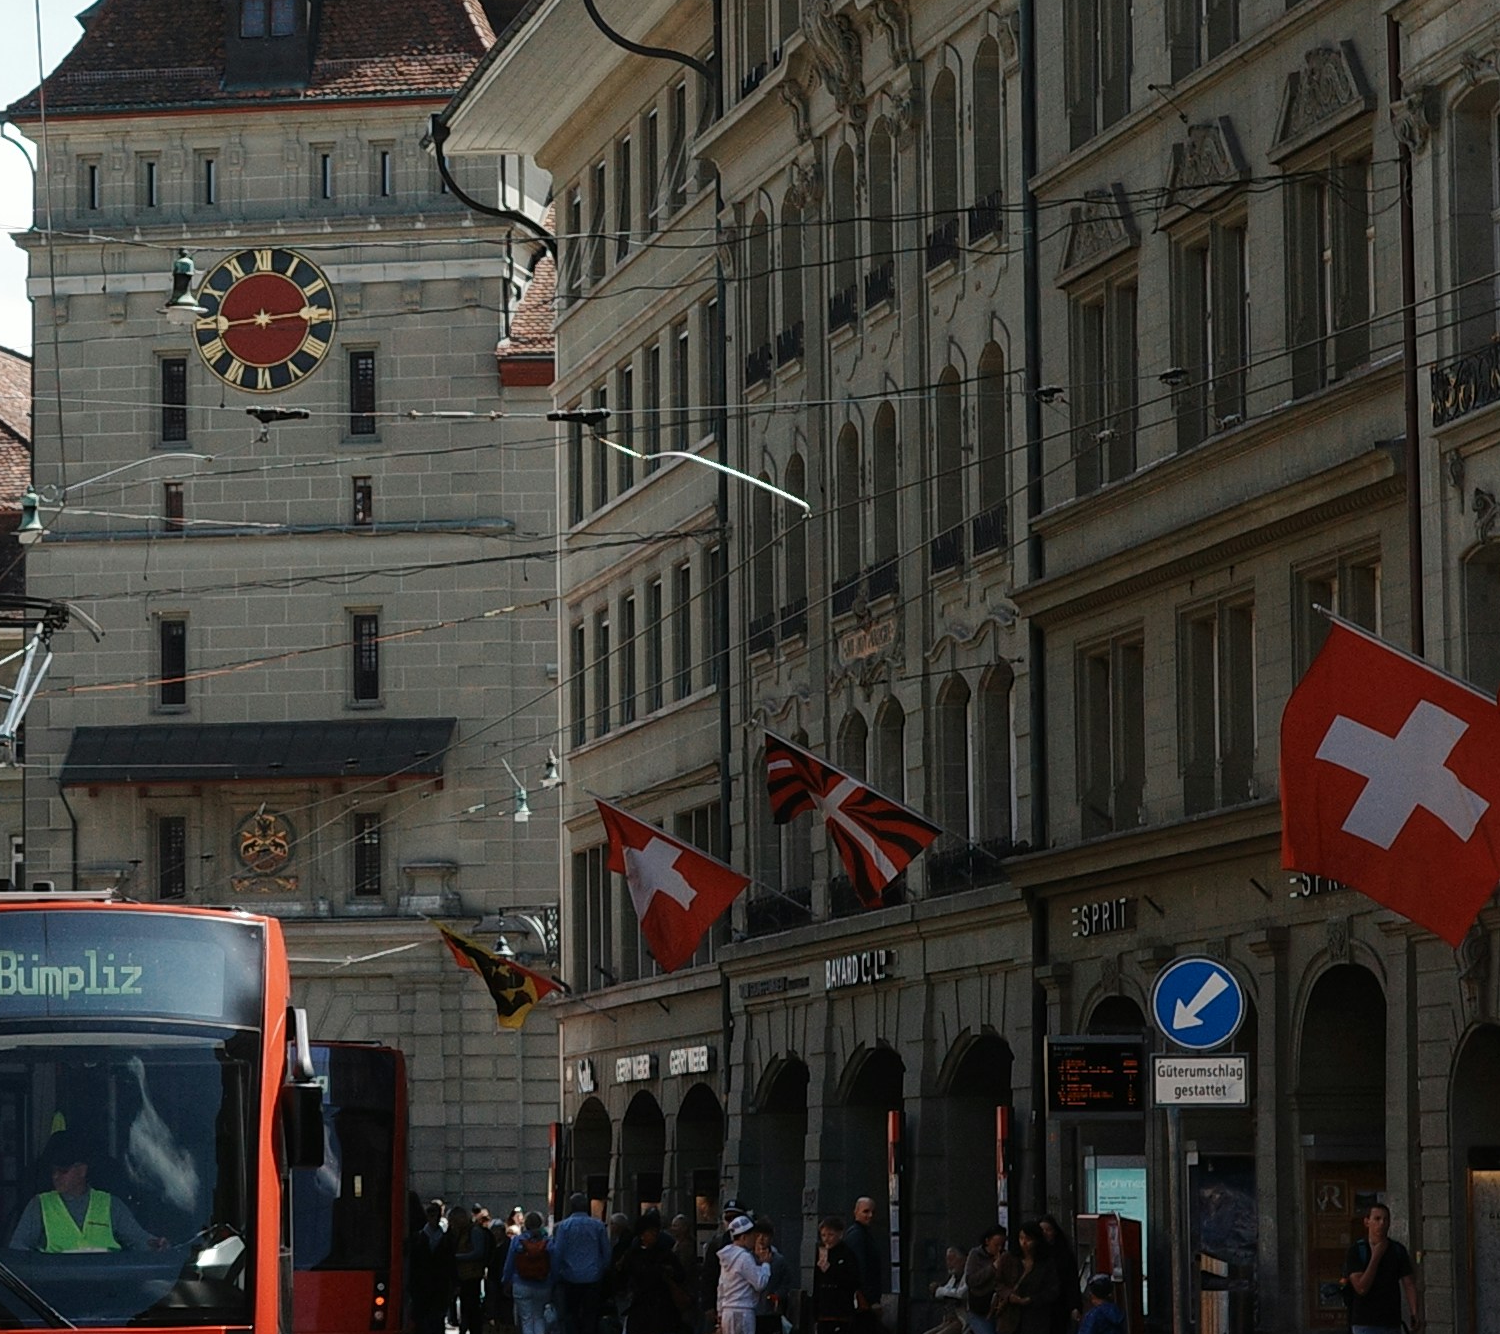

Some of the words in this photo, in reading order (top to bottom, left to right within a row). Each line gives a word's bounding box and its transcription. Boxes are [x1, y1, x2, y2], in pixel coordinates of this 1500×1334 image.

[223, 257, 246, 283] XI
[254, 250, 273, 271] XII
[202, 283, 225, 302] X
[303, 278, 326, 297] II
[257, 367, 273, 389] VI
[1072, 897, 1127, 937] ESPRIT
[825, 954, 858, 989] BAYARD
[1157, 1063, 1243, 1080] Güterumschlag
[1174, 1084, 1227, 1099] gestattet
